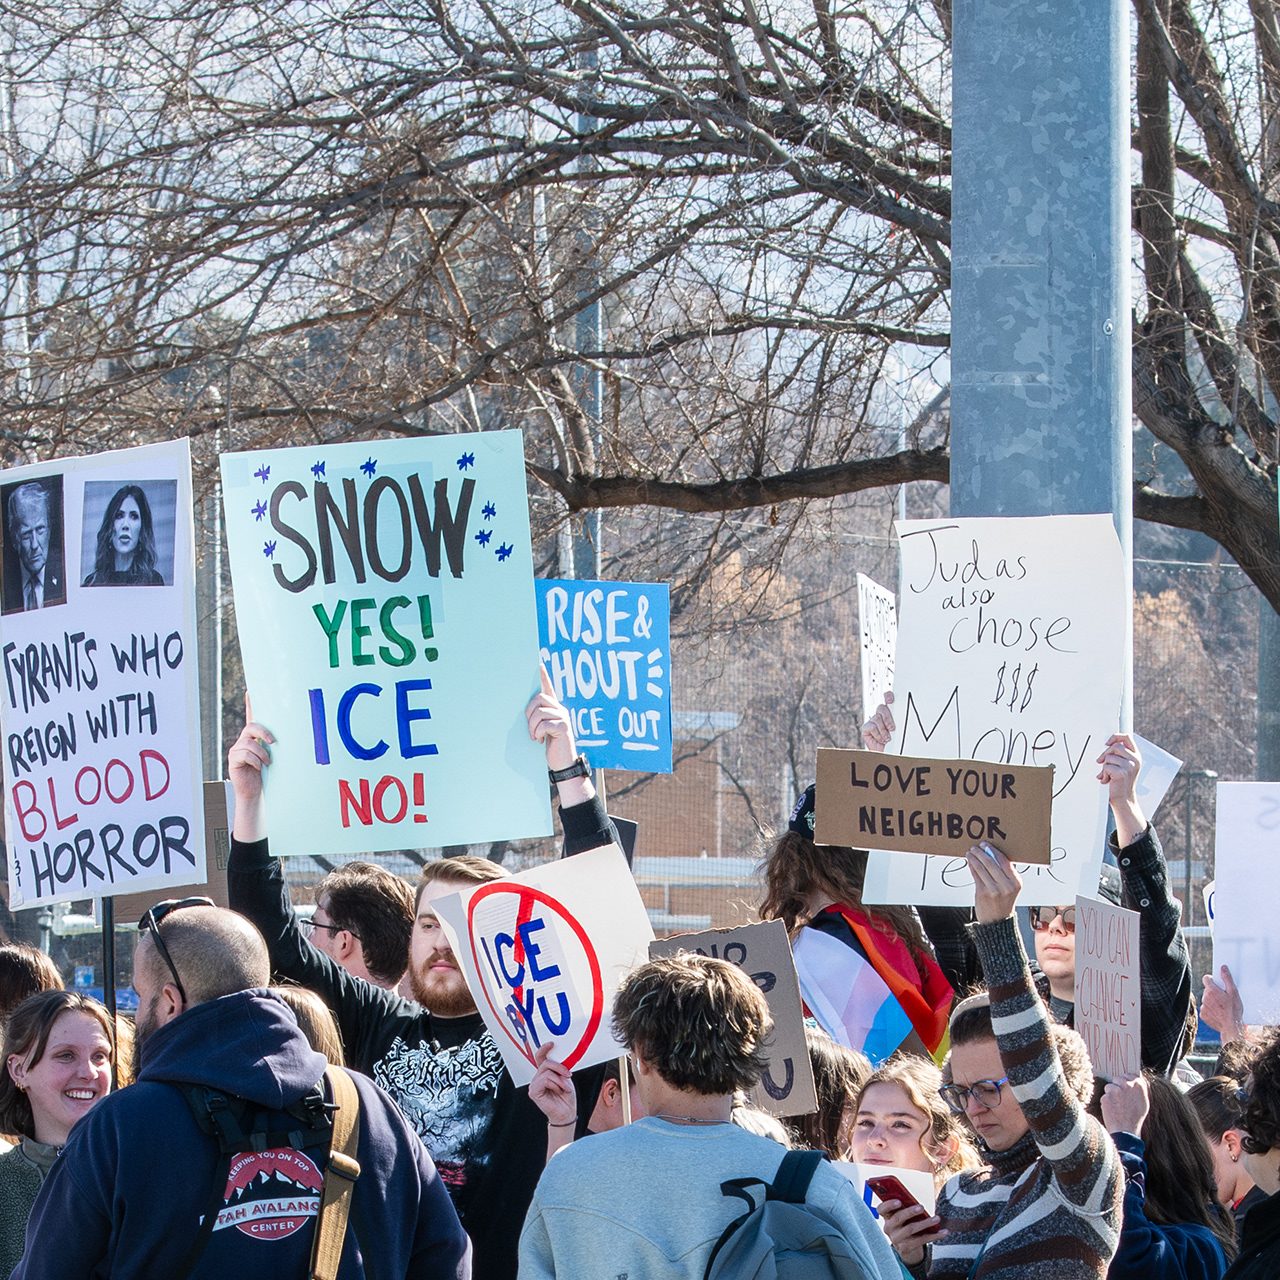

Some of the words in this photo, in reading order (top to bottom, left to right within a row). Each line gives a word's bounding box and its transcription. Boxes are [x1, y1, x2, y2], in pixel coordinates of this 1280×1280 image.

[269, 472, 477, 594] SNOW
[900, 524, 1029, 595] Judas
[545, 586, 631, 646] RISE
[632, 594, 653, 640] &
[940, 586, 996, 611] also
[311, 593, 440, 669] YES!
[948, 605, 1079, 654] chose
[3, 629, 98, 714] TYRANTS
[110, 629, 184, 680] WHO
[990, 660, 1040, 714] $$$
[8, 723, 78, 778] REIGN
[86, 691, 159, 742] WITH
[307, 677, 439, 766] ICE
[617, 706, 662, 741] OUT
[899, 684, 1093, 799] Money
[12, 748, 172, 843] BLOOD
[338, 772, 430, 829] NO!
[850, 761, 931, 797] LOVE
[946, 768, 1018, 800] YOUR
[858, 805, 1008, 841] NEIGHBOR
[30, 814, 197, 898] HORROR
[480, 917, 562, 990] ICE
[1079, 905, 1105, 960] YOU
[1108, 913, 1131, 968] CAN
[504, 987, 572, 1050] BYU
[1078, 966, 1130, 1027] CHANGE
[1105, 1026, 1138, 1077] MIND
[227, 1154, 256, 1182] KEEPING
[257, 1151, 276, 1160] YOU
[277, 1152, 293, 1162] ON
[294, 1157, 311, 1173] TOP
[216, 1207, 248, 1226] TAH
[251, 1200, 320, 1216] AVALANC
[250, 1220, 296, 1233] CENTER
